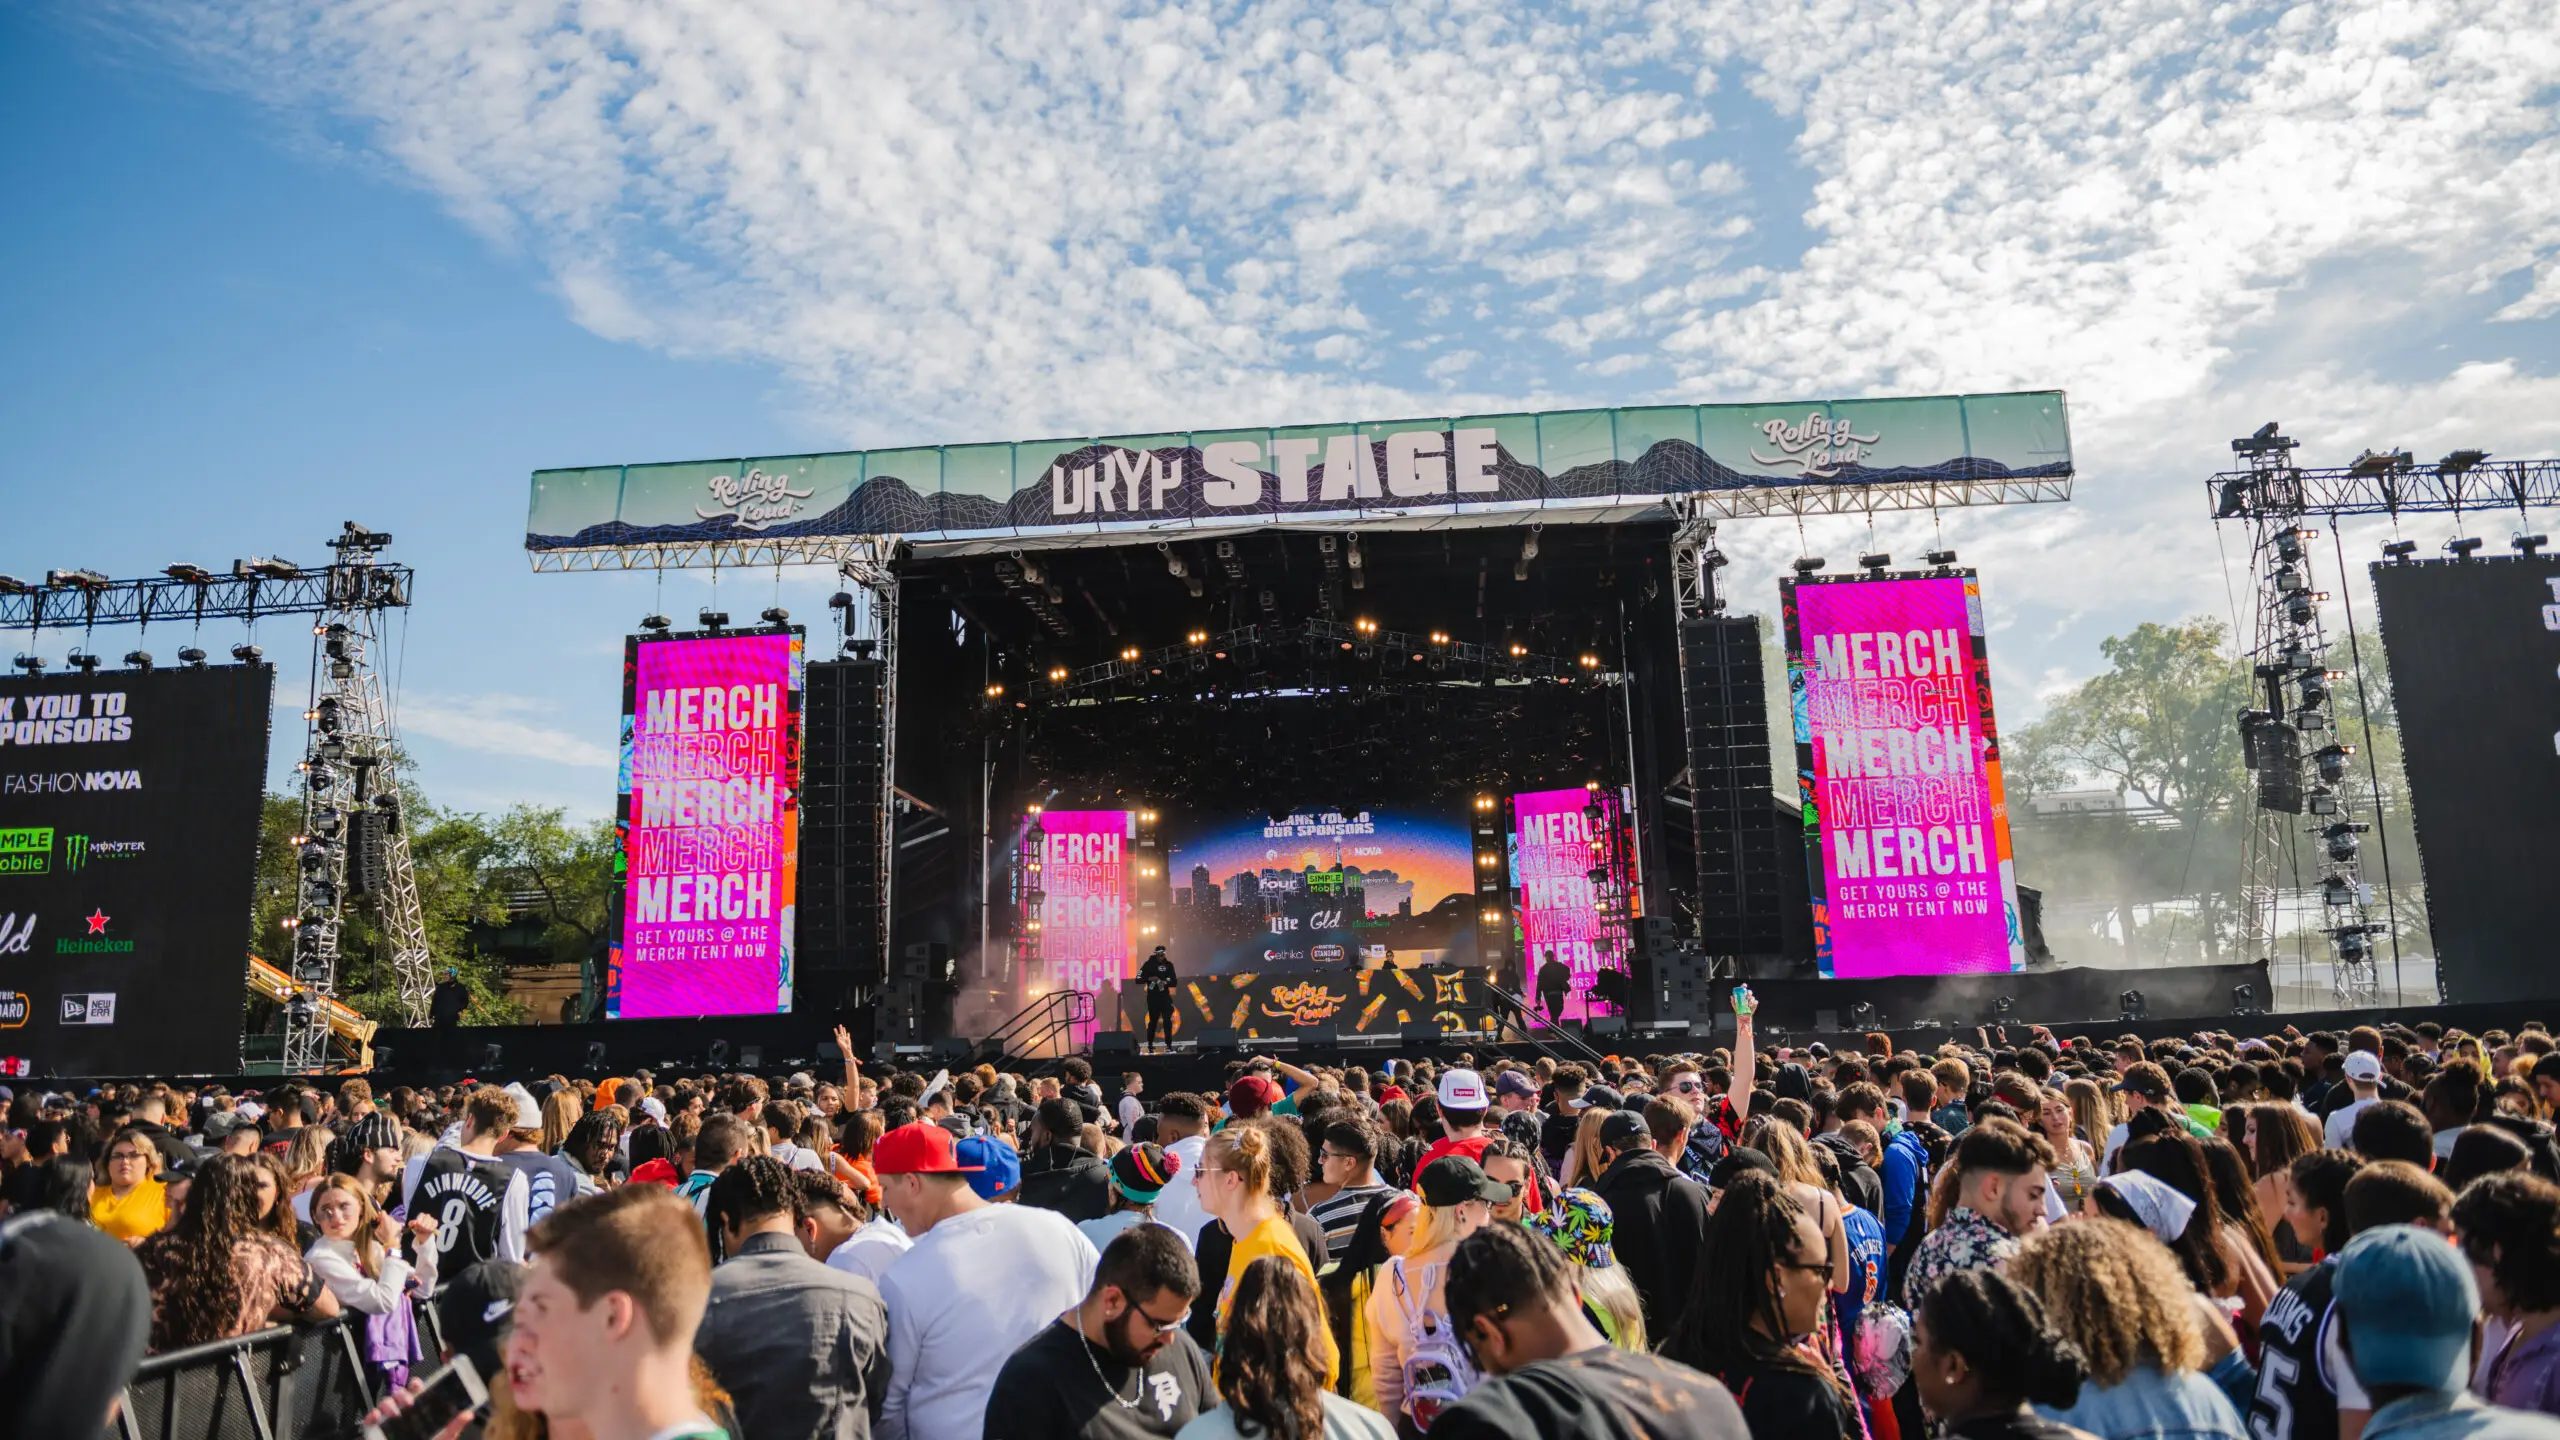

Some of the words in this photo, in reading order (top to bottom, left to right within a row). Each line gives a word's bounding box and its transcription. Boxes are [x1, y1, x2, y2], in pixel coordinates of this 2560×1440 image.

[1763, 412, 1880, 453] Rolling
[1203, 427, 1499, 507] STAGE
[1751, 442, 1860, 478] Loud
[709, 468, 815, 507] Rolling
[696, 498, 795, 531] Loud
[1813, 628, 1962, 680] MERCH
[25, 694, 81, 719] YOU
[91, 692, 127, 717] TO
[645, 684, 777, 734] MERCH
[1819, 677, 1969, 729] MERCH
[643, 730, 776, 780] MERCH
[1823, 725, 1974, 778] MERCH
[641, 776, 774, 828] MERCH
[1828, 774, 1981, 829] MERCH
[90, 841, 146, 853] MONSTER
[638, 825, 773, 875] MERCH
[1264, 826, 1293, 838] OUR
[1297, 823, 1374, 836] SPONSORS
[1833, 825, 1987, 879] MERCH
[636, 871, 771, 924] MERCH
[1309, 874, 1341, 883] SIMPLE
[1840, 886, 1868, 900] GET
[1876, 884, 1928, 899] YOURS
[1936, 882, 1950, 898] @
[1957, 881, 1988, 896] THE
[1271, 917, 1299, 934] Lite
[1843, 902, 1899, 918] MERCH
[1906, 901, 1945, 917] TENT
[1953, 899, 1988, 915] NOW
[56, 938, 134, 954] Heineken
[636, 930, 662, 944] GET
[669, 928, 715, 942] YOURS
[720, 927, 735, 942] @
[741, 926, 768, 940] THE
[636, 946, 685, 962] MERCH
[693, 944, 728, 960] TENT
[734, 943, 767, 958] NOW
[91, 1008, 110, 1017] ERA
[92, 1000, 111, 1009] NEW
[424, 1172, 497, 1211] DINWIDDIE
[436, 1198, 466, 1253] 8
[1863, 1261, 1878, 1304] 6
